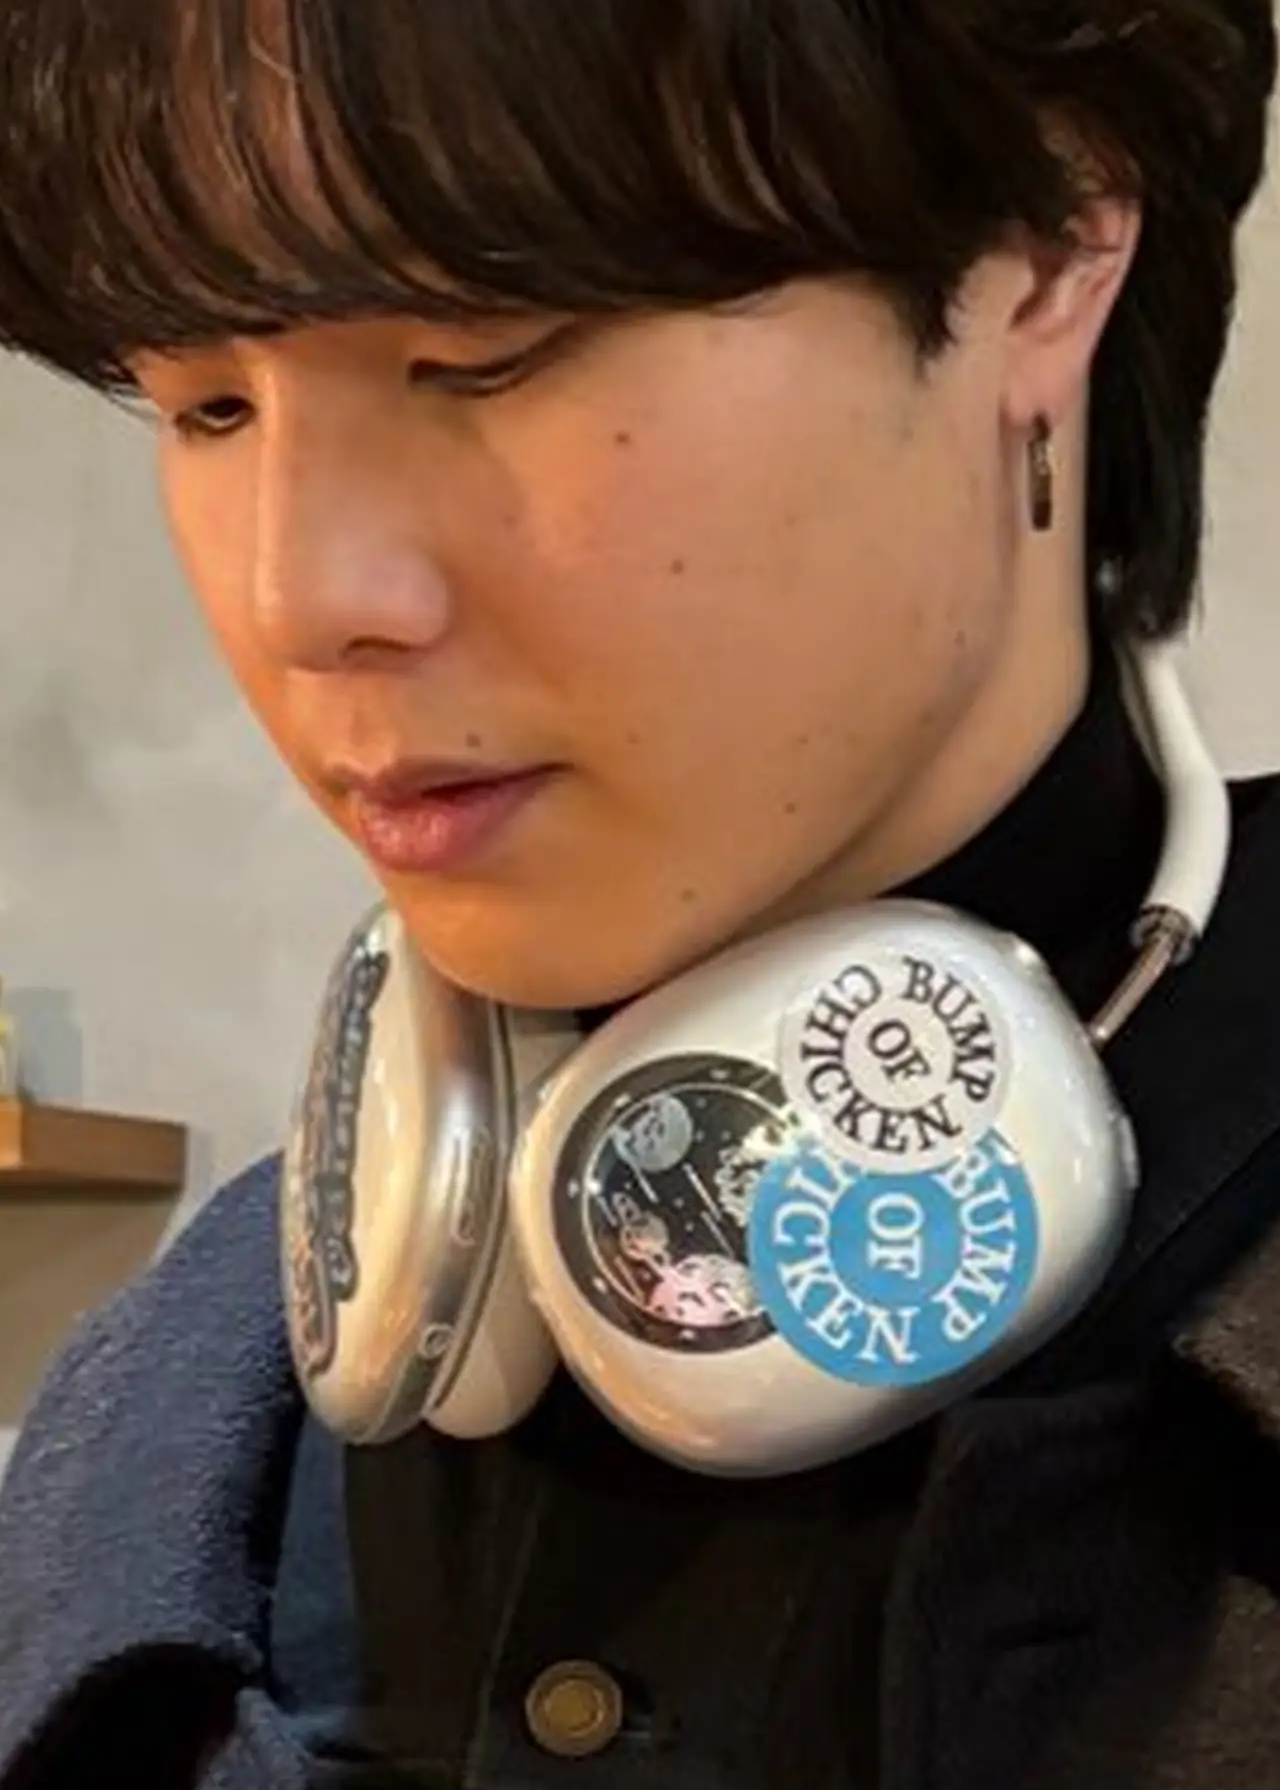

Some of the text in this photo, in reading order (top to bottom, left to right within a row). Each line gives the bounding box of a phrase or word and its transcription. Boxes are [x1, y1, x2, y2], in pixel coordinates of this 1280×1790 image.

[801, 956, 995, 1154] BUMP OF CHICKEN
[773, 1147, 1016, 1363] BUMP OF ICKEN
